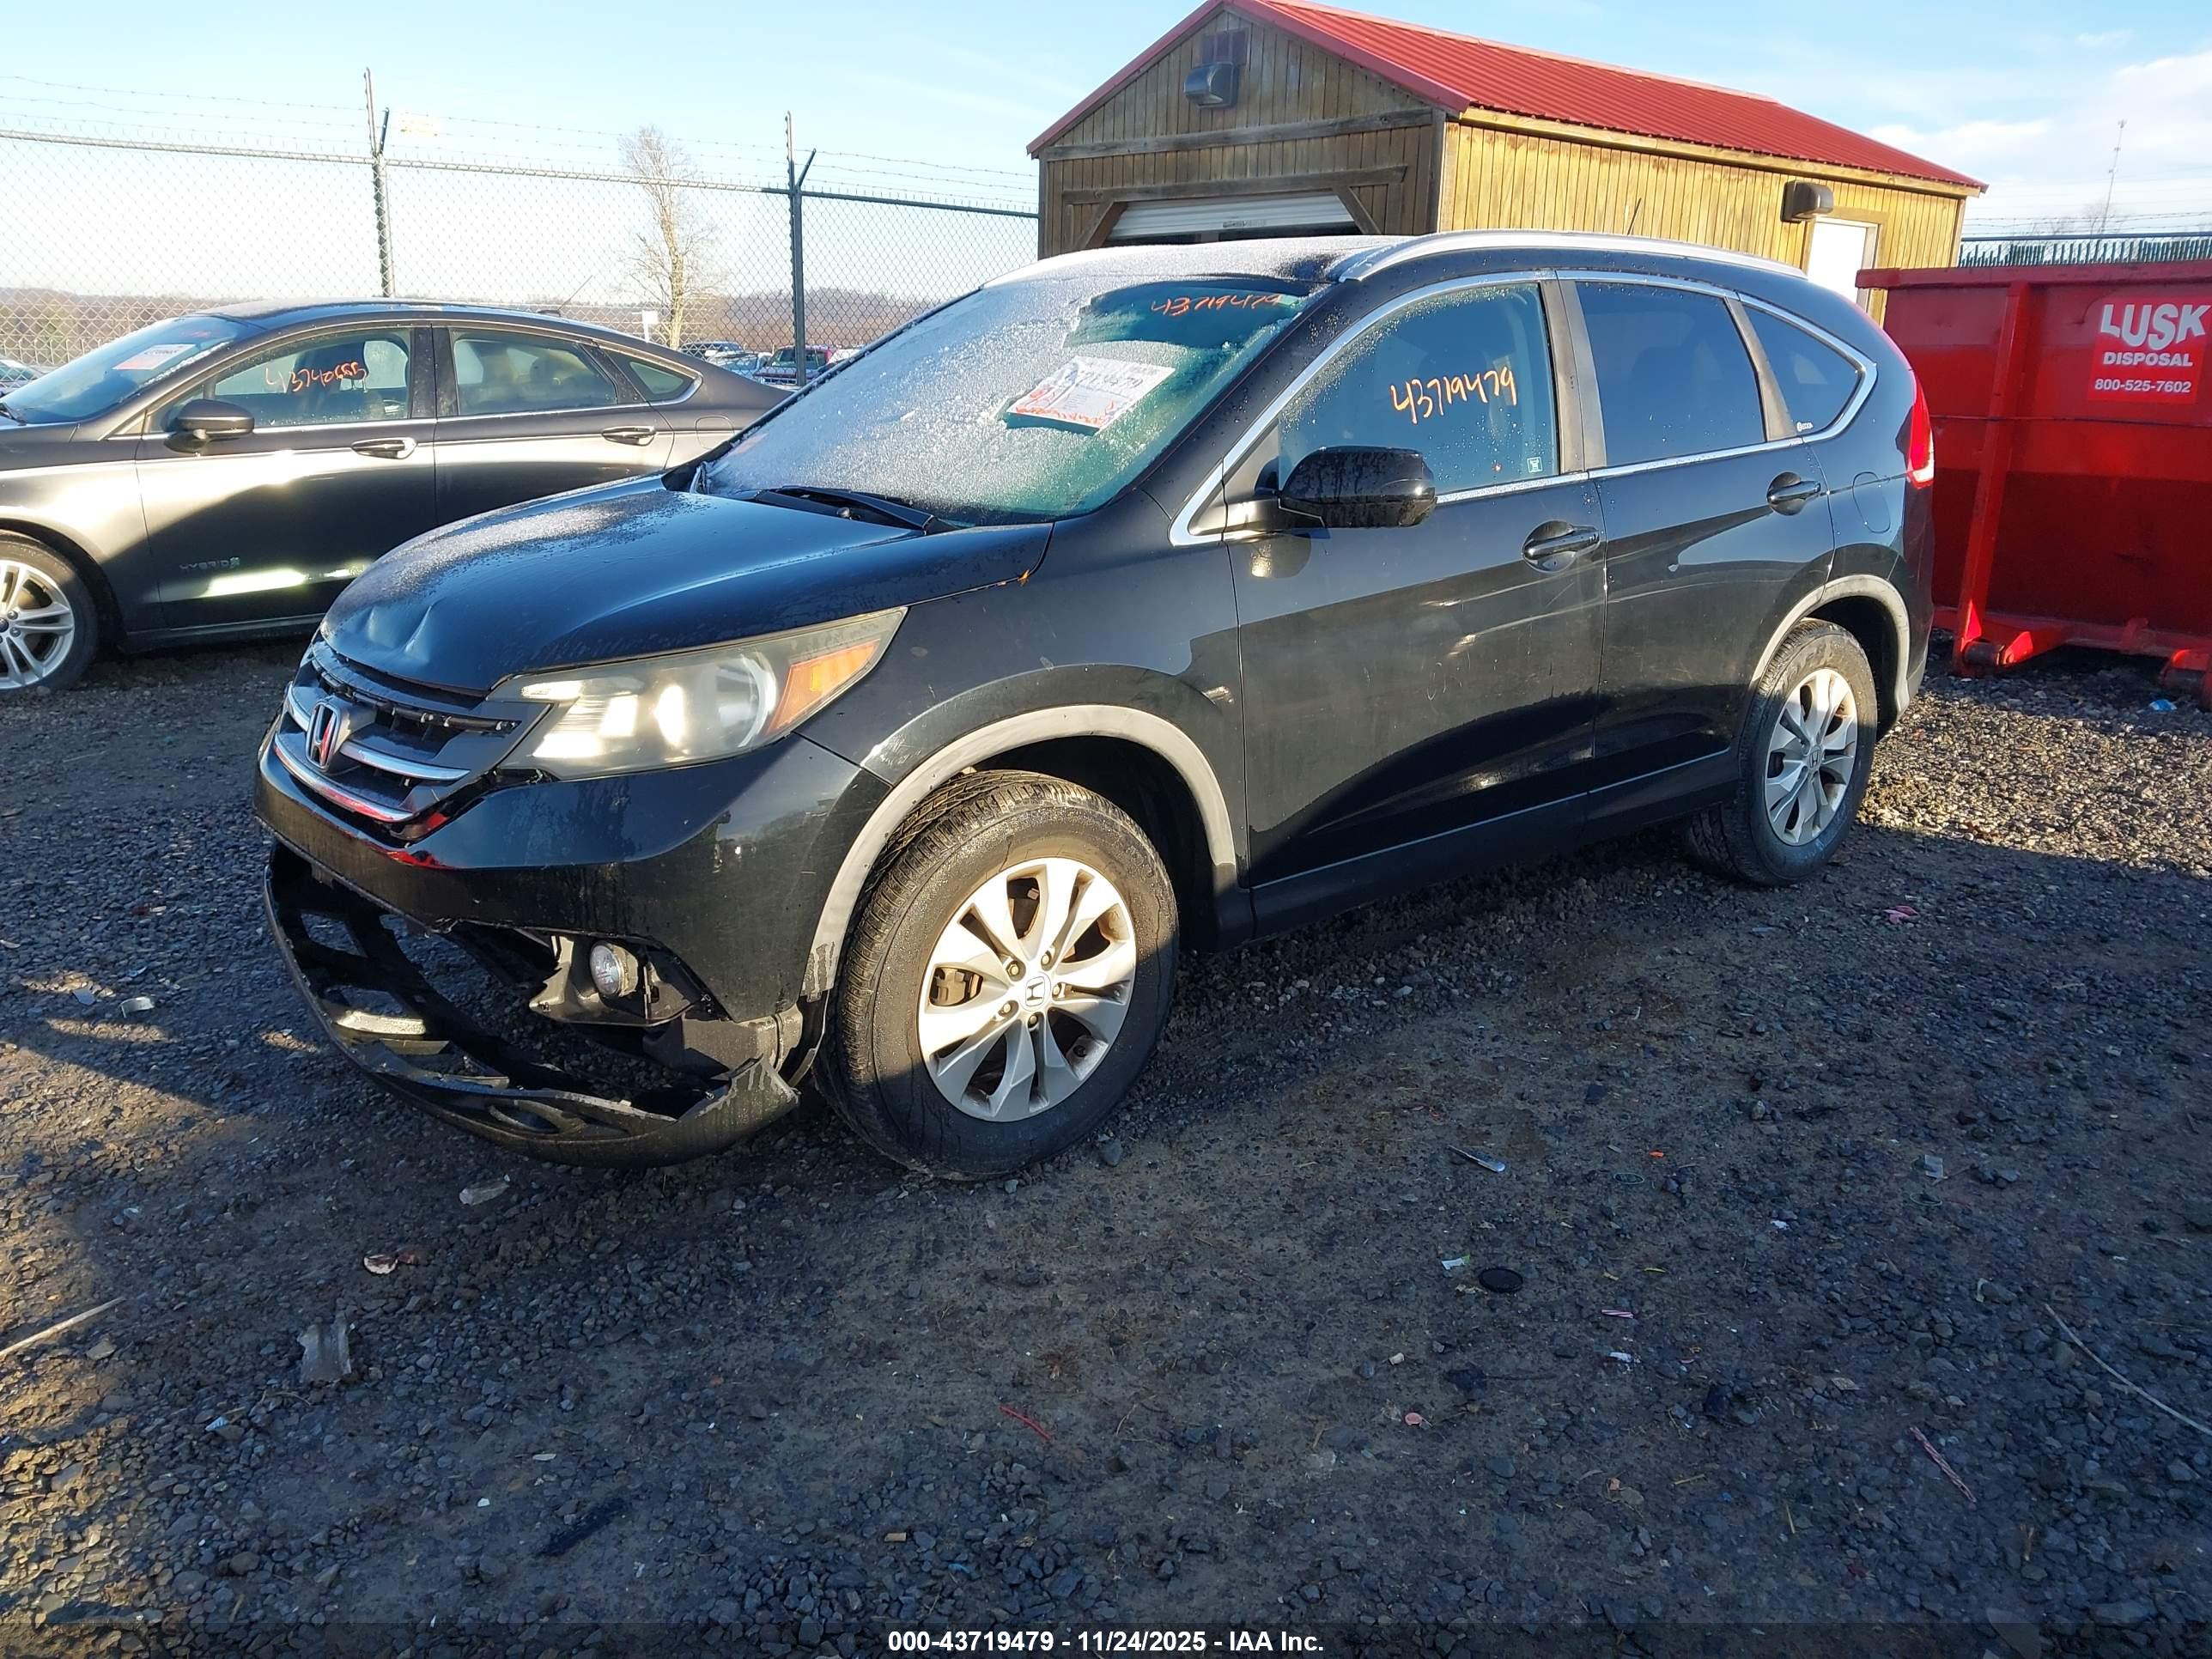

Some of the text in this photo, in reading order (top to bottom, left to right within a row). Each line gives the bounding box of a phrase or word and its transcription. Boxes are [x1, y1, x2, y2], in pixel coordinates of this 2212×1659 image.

[1151, 294, 1282, 317] 43719479
[2100, 303, 2211, 350] LUSK
[2103, 351, 2193, 367] DISPOSAL
[1390, 366, 1517, 424] 43719479
[2094, 378, 2192, 393] 800-525-7602
